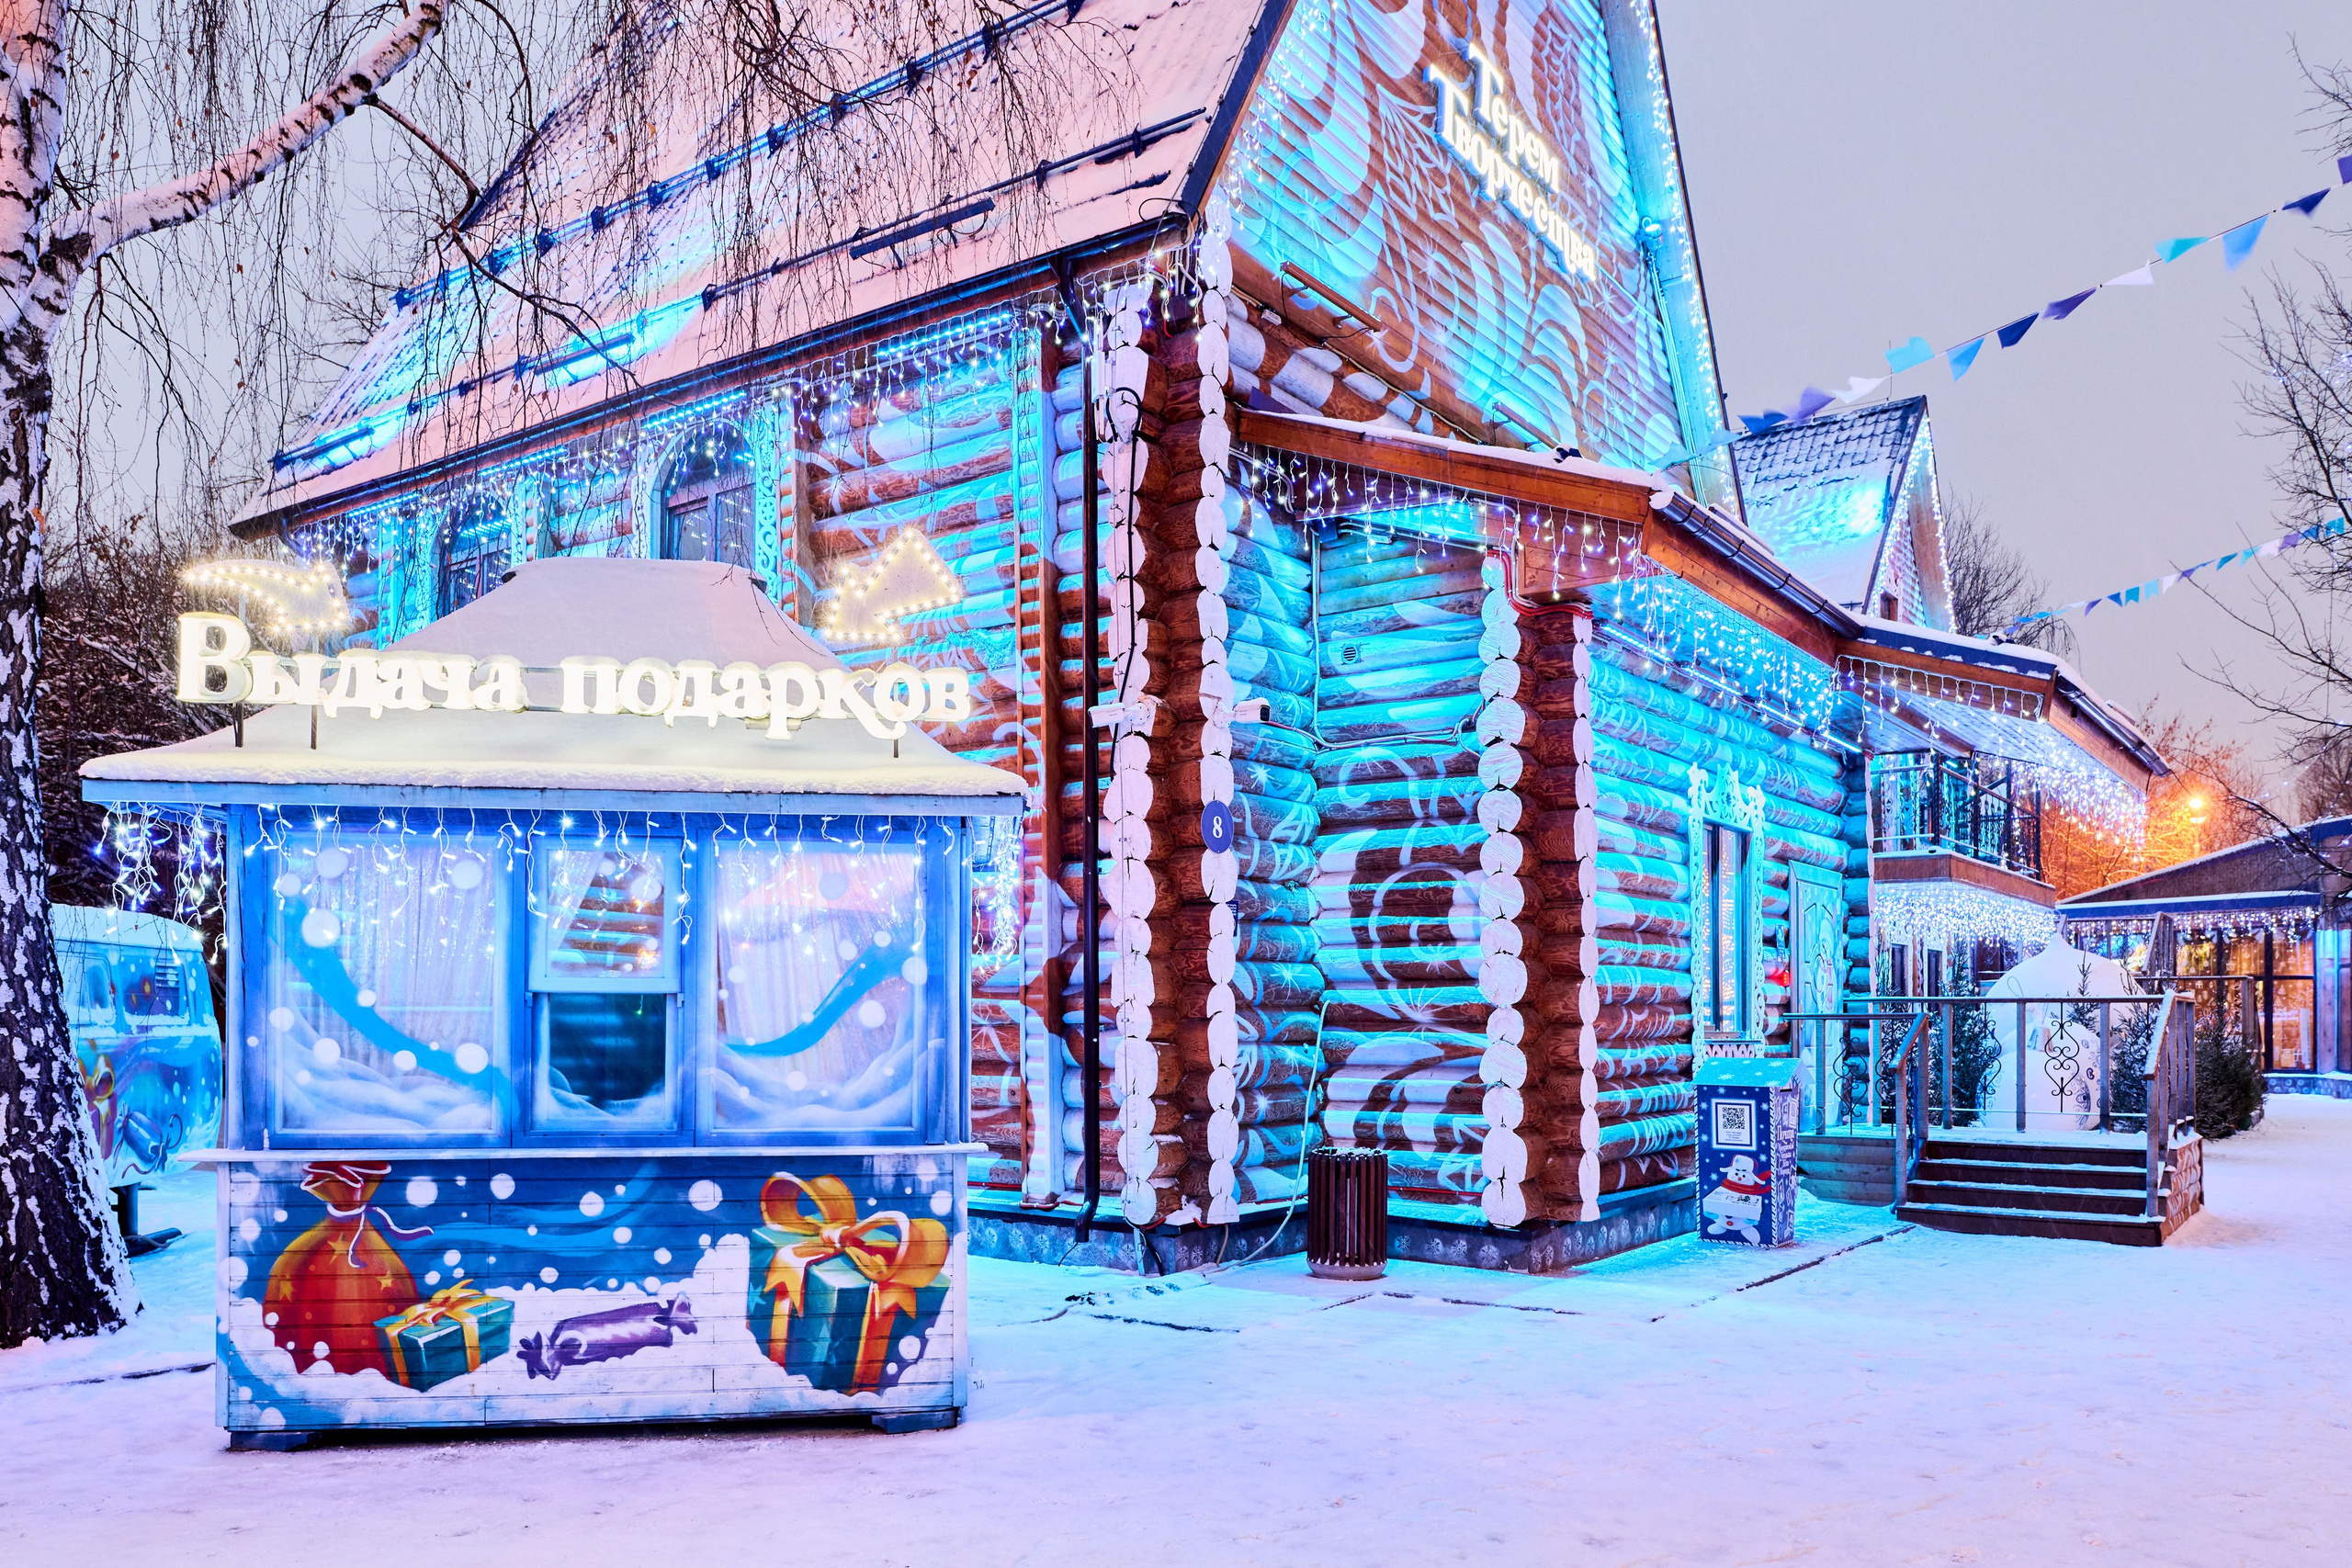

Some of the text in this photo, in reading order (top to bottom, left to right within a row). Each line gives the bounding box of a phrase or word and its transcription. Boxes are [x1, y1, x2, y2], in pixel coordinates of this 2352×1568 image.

[1428, 63, 1597, 282] Творчества
[1468, 42, 1560, 195] Терем
[176, 612, 972, 740] Выдача подарков
[1213, 816, 1223, 839] 8
